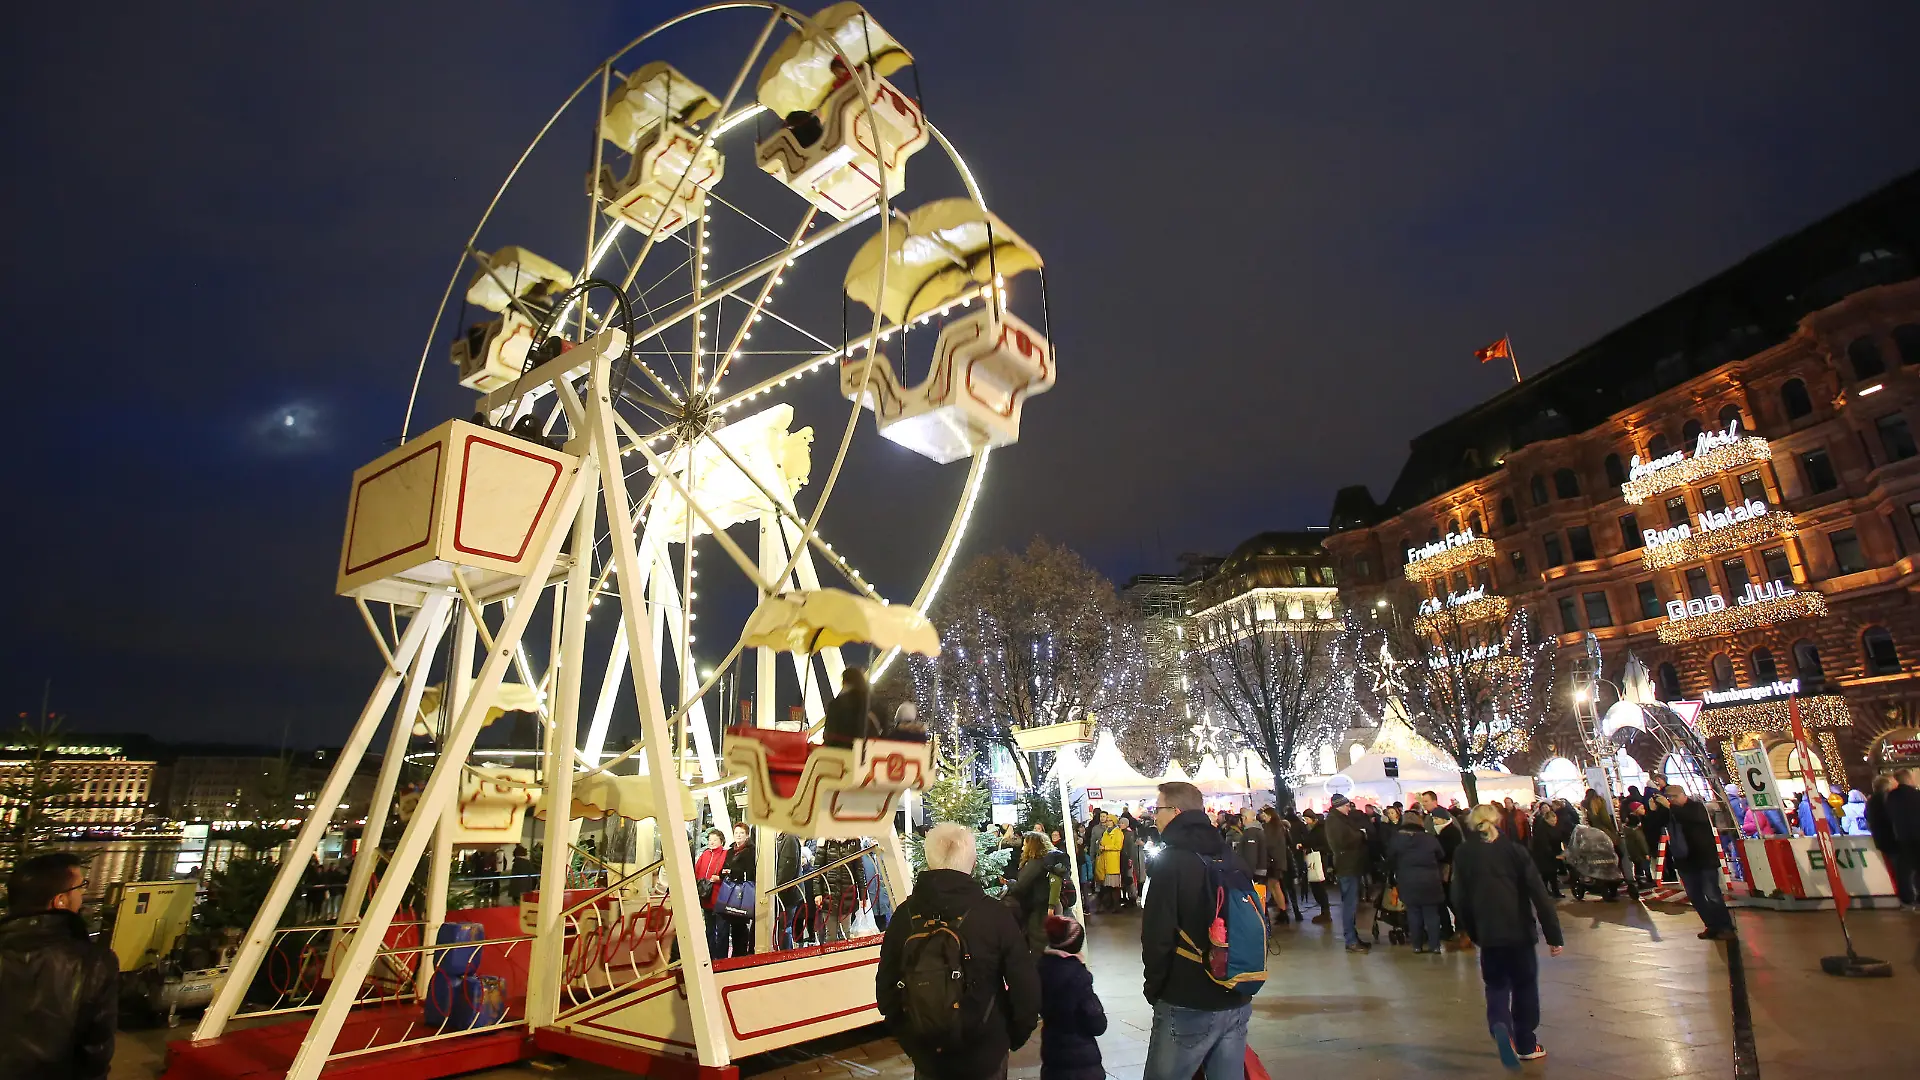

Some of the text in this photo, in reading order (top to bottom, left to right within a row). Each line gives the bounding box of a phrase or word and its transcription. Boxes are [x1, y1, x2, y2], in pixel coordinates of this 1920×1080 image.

[1642, 498, 1767, 549] Buon Natale
[1703, 678, 1799, 705] Hamburger Hof
[1736, 752, 1764, 767] EXIT
[1746, 767, 1766, 792] C
[1807, 847, 1868, 870] EXIT
